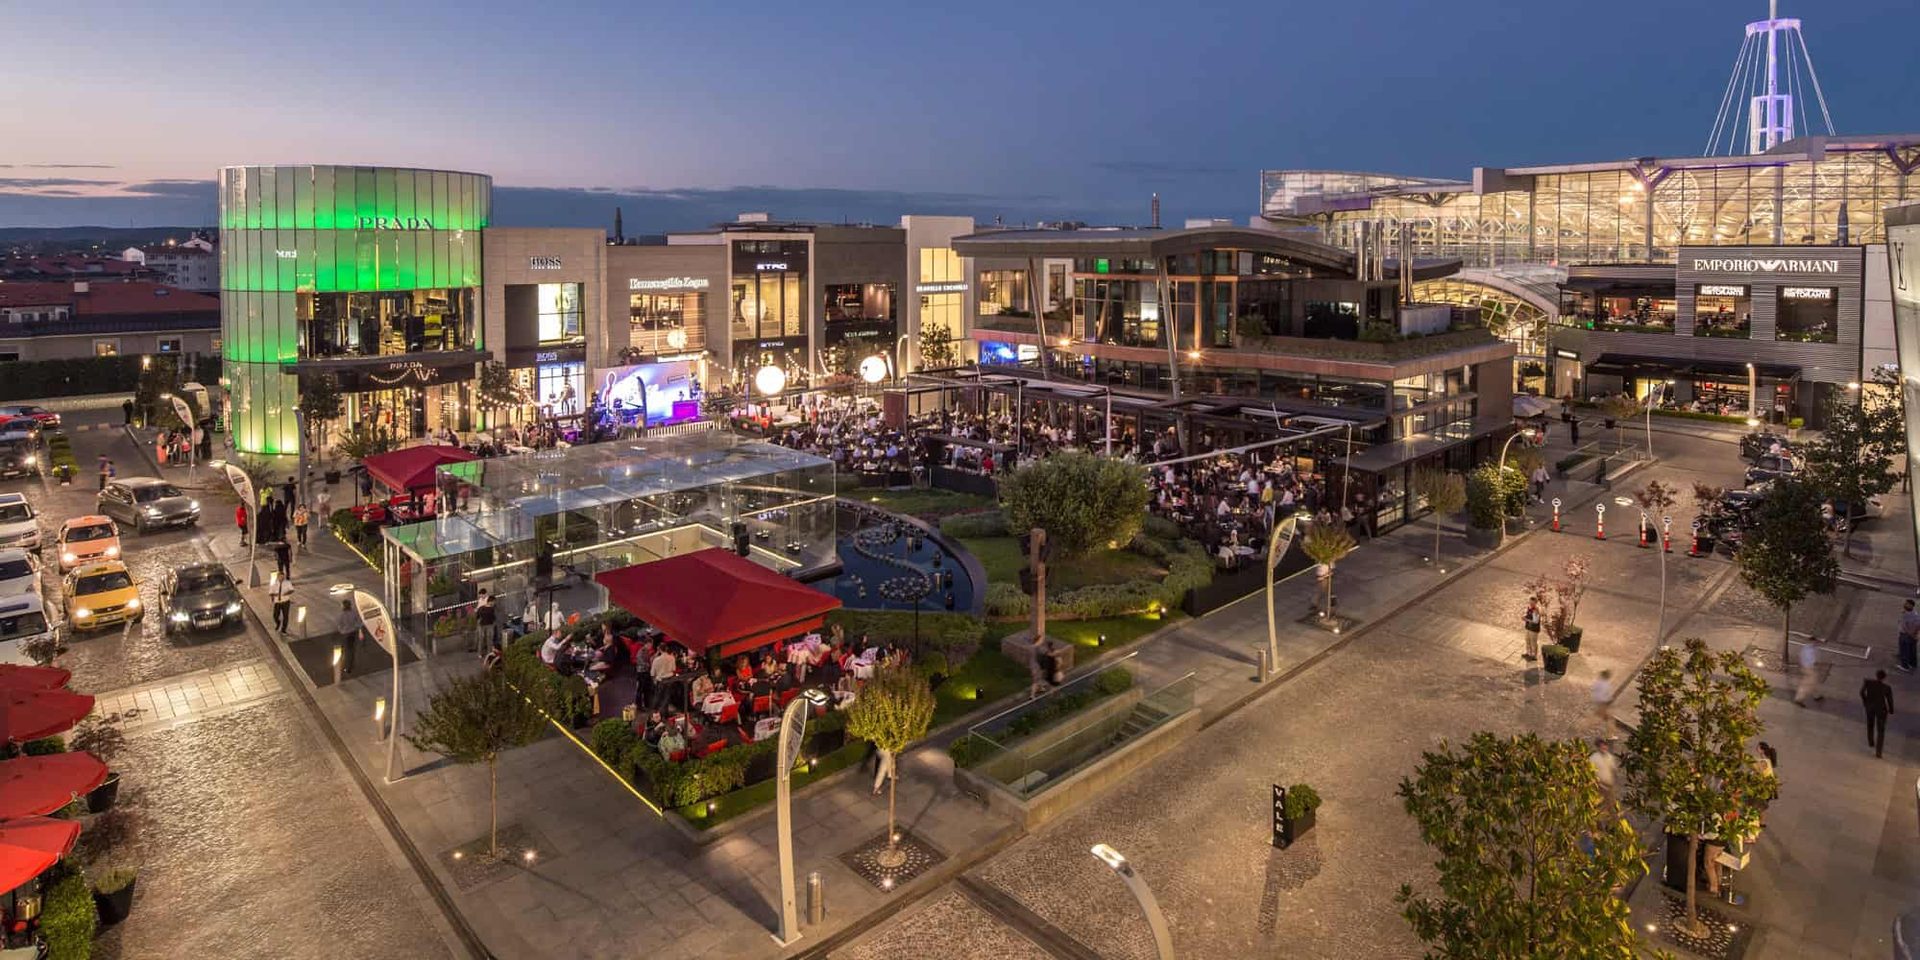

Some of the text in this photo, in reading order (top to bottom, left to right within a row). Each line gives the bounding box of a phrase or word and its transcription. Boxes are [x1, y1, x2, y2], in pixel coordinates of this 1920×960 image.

[359, 216, 433, 231] PRADA
[1694, 259, 1839, 273] EMPORIO ARMANI
